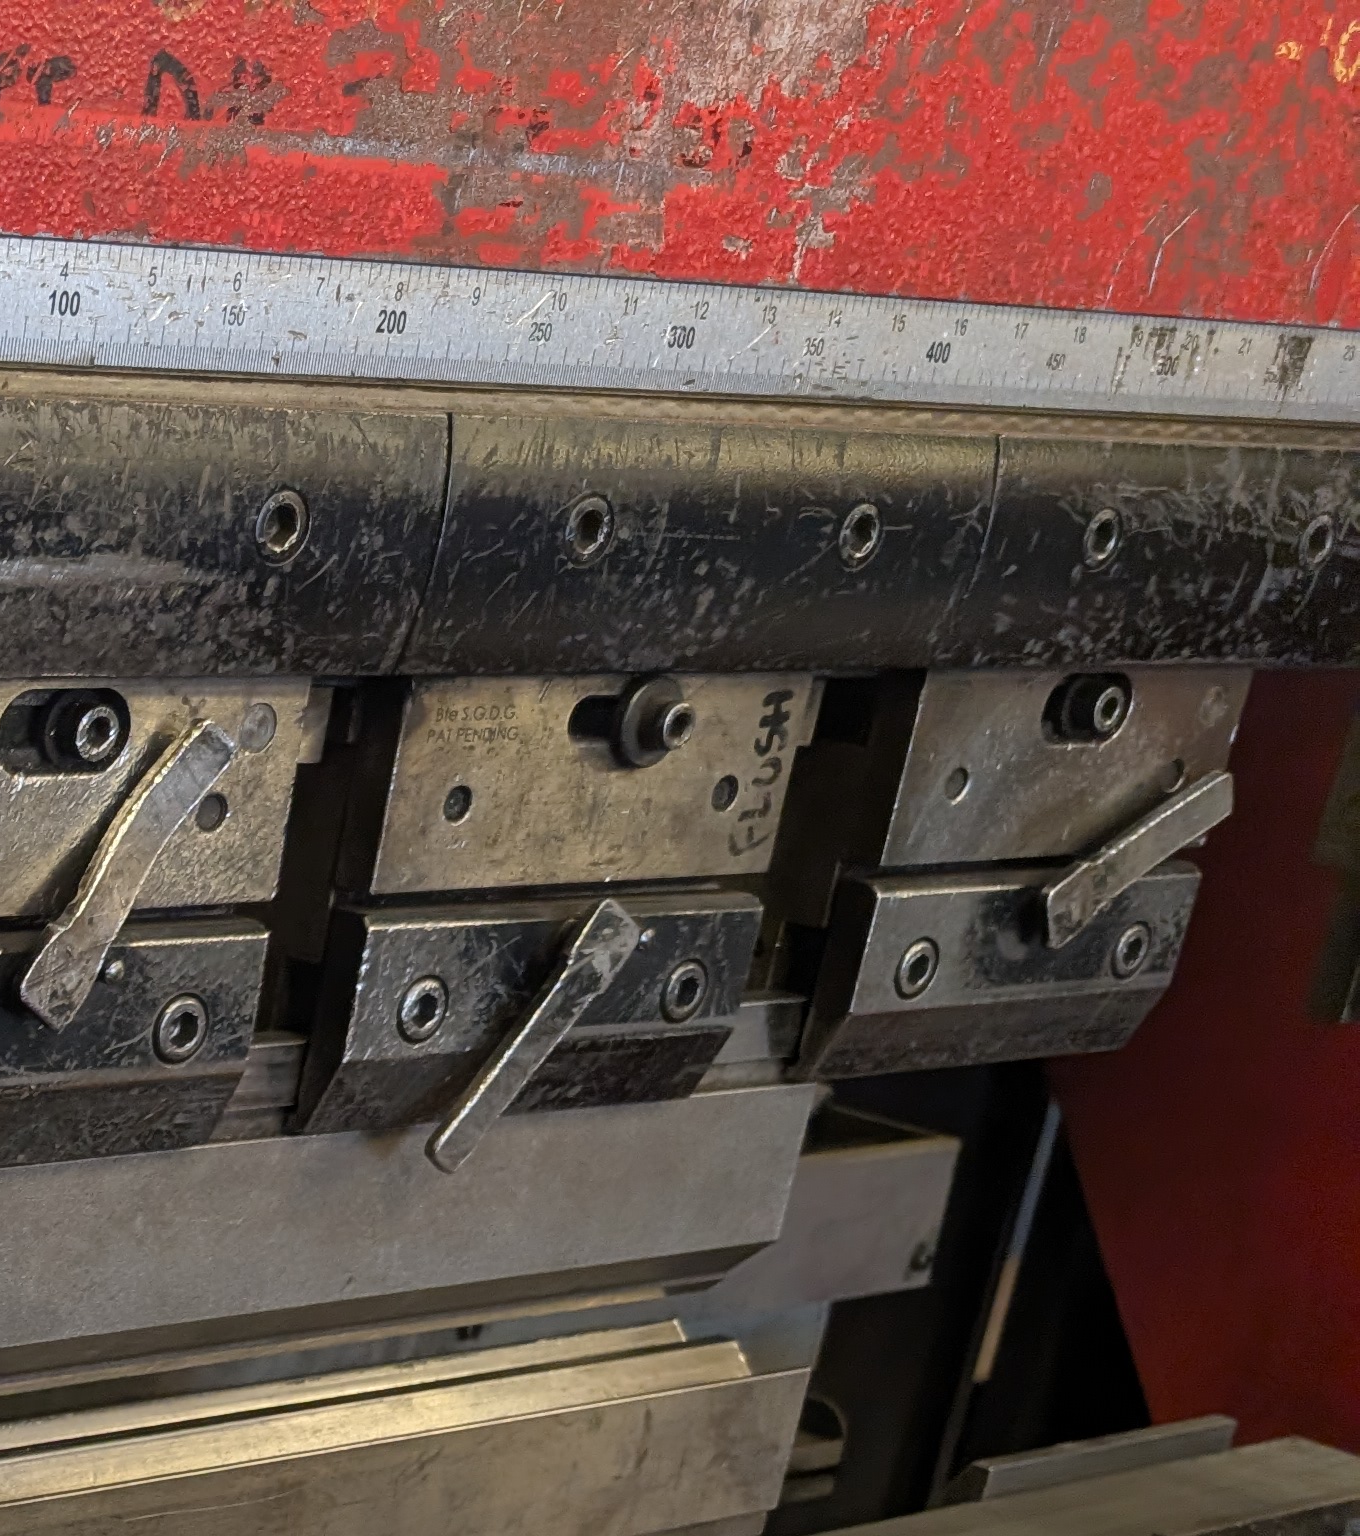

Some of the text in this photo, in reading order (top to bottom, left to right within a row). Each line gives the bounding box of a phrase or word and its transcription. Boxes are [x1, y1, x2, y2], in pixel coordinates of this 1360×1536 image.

[47, 290, 81, 317] 100
[219, 303, 248, 328] 150
[375, 310, 407, 336] 200
[528, 322, 553, 343] 250
[667, 326, 695, 350] 300
[803, 336, 825, 358] 350
[926, 341, 951, 365] 400
[1046, 353, 1066, 372] 450
[58, 262, 70, 283] 4
[147, 267, 159, 288] 5
[232, 272, 243, 293] 6
[316, 276, 326, 297] 7
[394, 282, 404, 303] 8
[471, 286, 482, 307] 9
[550, 291, 567, 312] 10
[623, 295, 640, 316] 11
[690, 301, 710, 321] 12
[761, 306, 778, 325] 13
[827, 309, 842, 329] 14
[891, 314, 907, 333] 15
[954, 318, 968, 337] 16
[1013, 322, 1030, 341] 17
[1073, 326, 1087, 345] 18
[1237, 337, 1253, 355] 21
[426, 725, 520, 745] PAT PENDING
[728, 688, 795, 857] FLUSH
